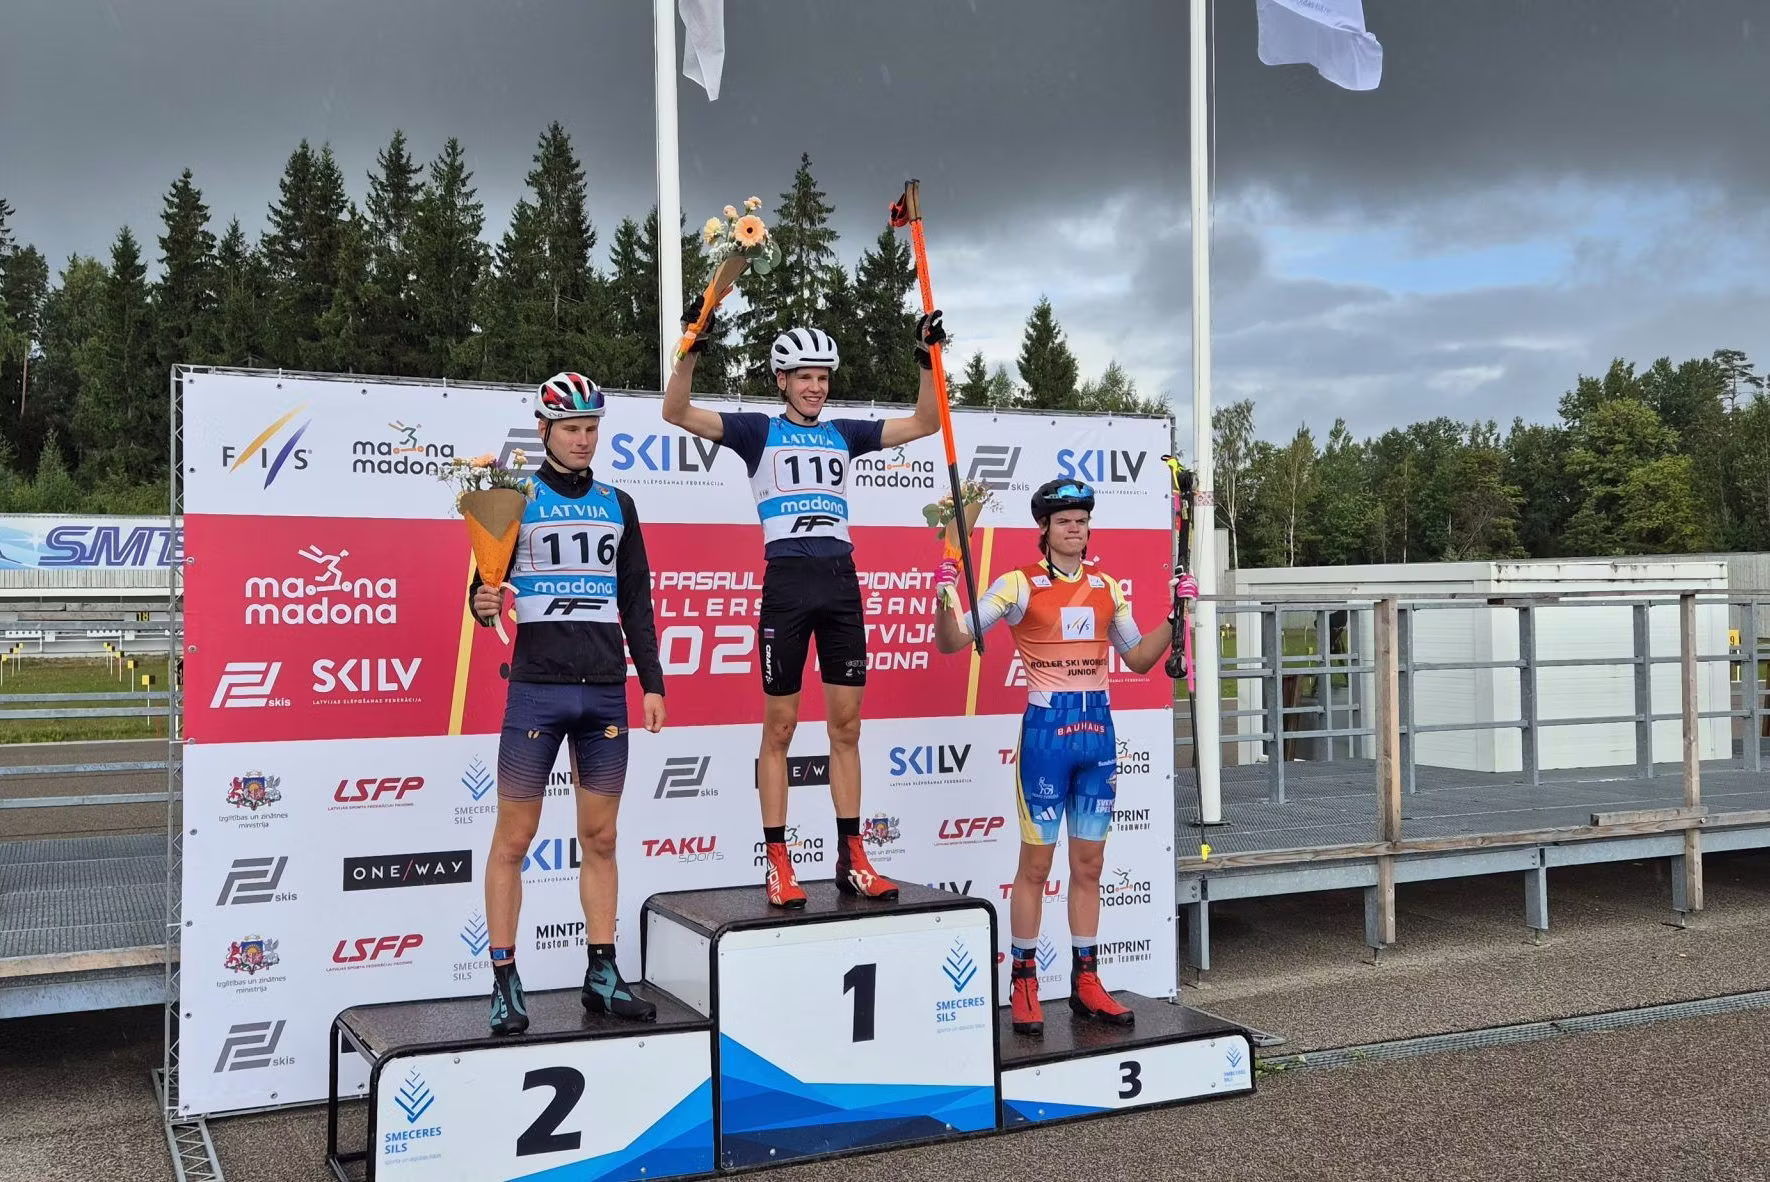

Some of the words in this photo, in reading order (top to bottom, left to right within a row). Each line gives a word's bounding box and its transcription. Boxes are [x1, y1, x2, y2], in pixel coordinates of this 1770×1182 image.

[784, 455, 844, 486] 119
[856, 472, 934, 488] madona
[1011, 483, 1030, 491] skis
[540, 504, 609, 519] LATVIJA
[780, 496, 844, 515] madona
[542, 531, 615, 565] 116
[535, 577, 613, 594] madona
[660, 571, 763, 590] PASAUL
[856, 567, 935, 590] PIONĀT
[245, 597, 397, 624] madona
[625, 625, 756, 676] 02
[1031, 660, 1063, 669] ROLLER
[1065, 659, 1080, 667] SKI
[1067, 668, 1097, 676] JUNIOR
[268, 697, 291, 707] skis
[1057, 722, 1105, 736] BAUHAUS
[1116, 761, 1150, 775] dona
[333, 776, 425, 802] LSFP
[544, 787, 570, 796] stom
[701, 788, 719, 797] skis
[454, 816, 473, 825] SILS
[1112, 809, 1150, 822] TPRINT
[938, 816, 1005, 839] LSFP
[642, 836, 716, 857] TAKU
[679, 850, 724, 864] sports
[275, 892, 298, 902] skis
[332, 933, 424, 964] LSFP
[536, 939, 569, 950] Custom
[1099, 940, 1151, 955] INTPRINT
[453, 961, 493, 971] SMECER
[453, 972, 472, 981] SILS
[843, 963, 876, 1043] 1
[936, 996, 985, 1011] SMECERES
[936, 1012, 956, 1023] SILS
[273, 1056, 295, 1067] skis
[1118, 1060, 1142, 1099] 3
[516, 1066, 585, 1157] 2
[385, 1127, 442, 1143] SMECERES
[385, 1143, 408, 1154] SILS
